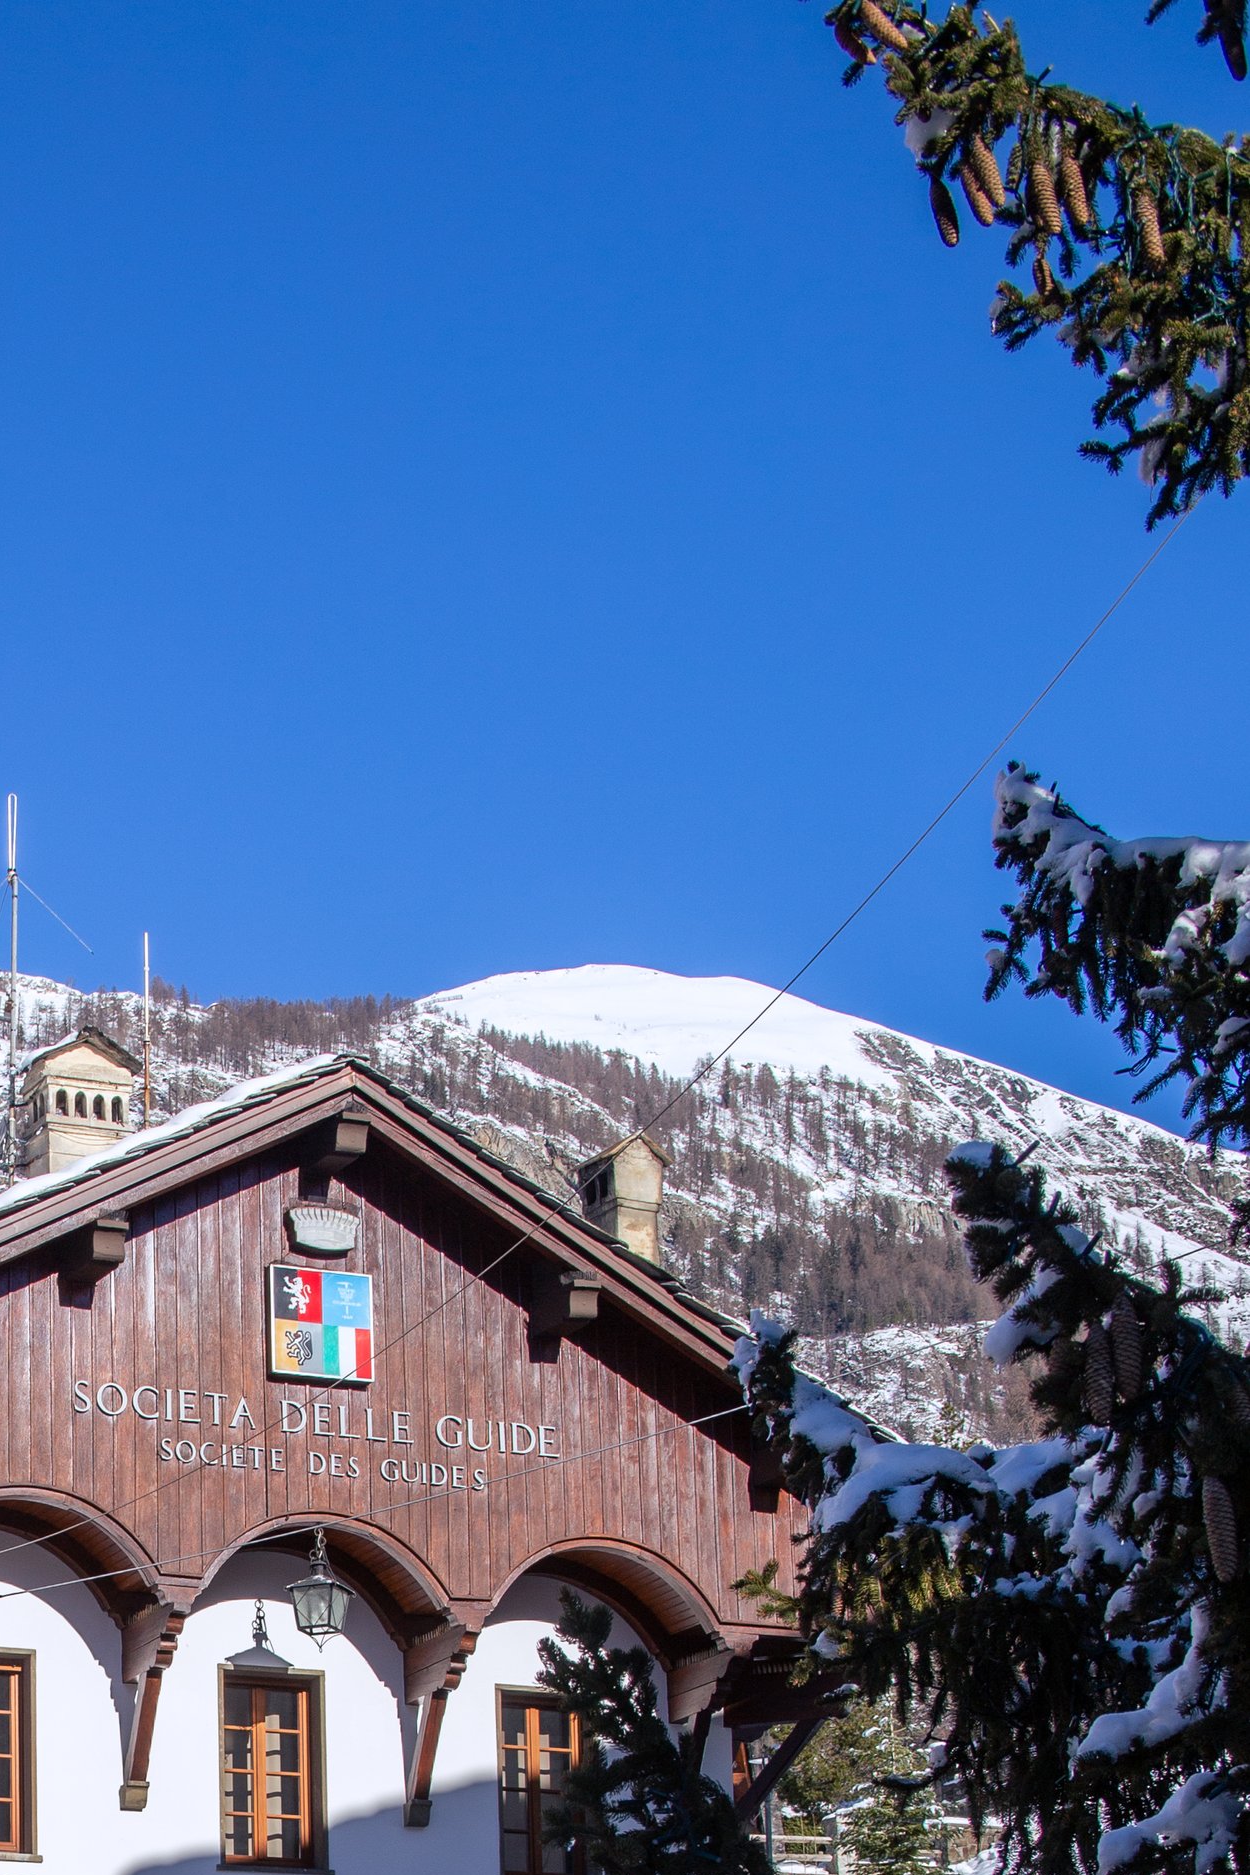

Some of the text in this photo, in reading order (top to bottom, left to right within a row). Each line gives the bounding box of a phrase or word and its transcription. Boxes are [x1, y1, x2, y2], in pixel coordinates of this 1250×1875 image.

[73, 1380, 561, 1458] SOCIETA DELLE GUIDE
[159, 1437, 486, 1491] SOCIETE DES GUIDES
